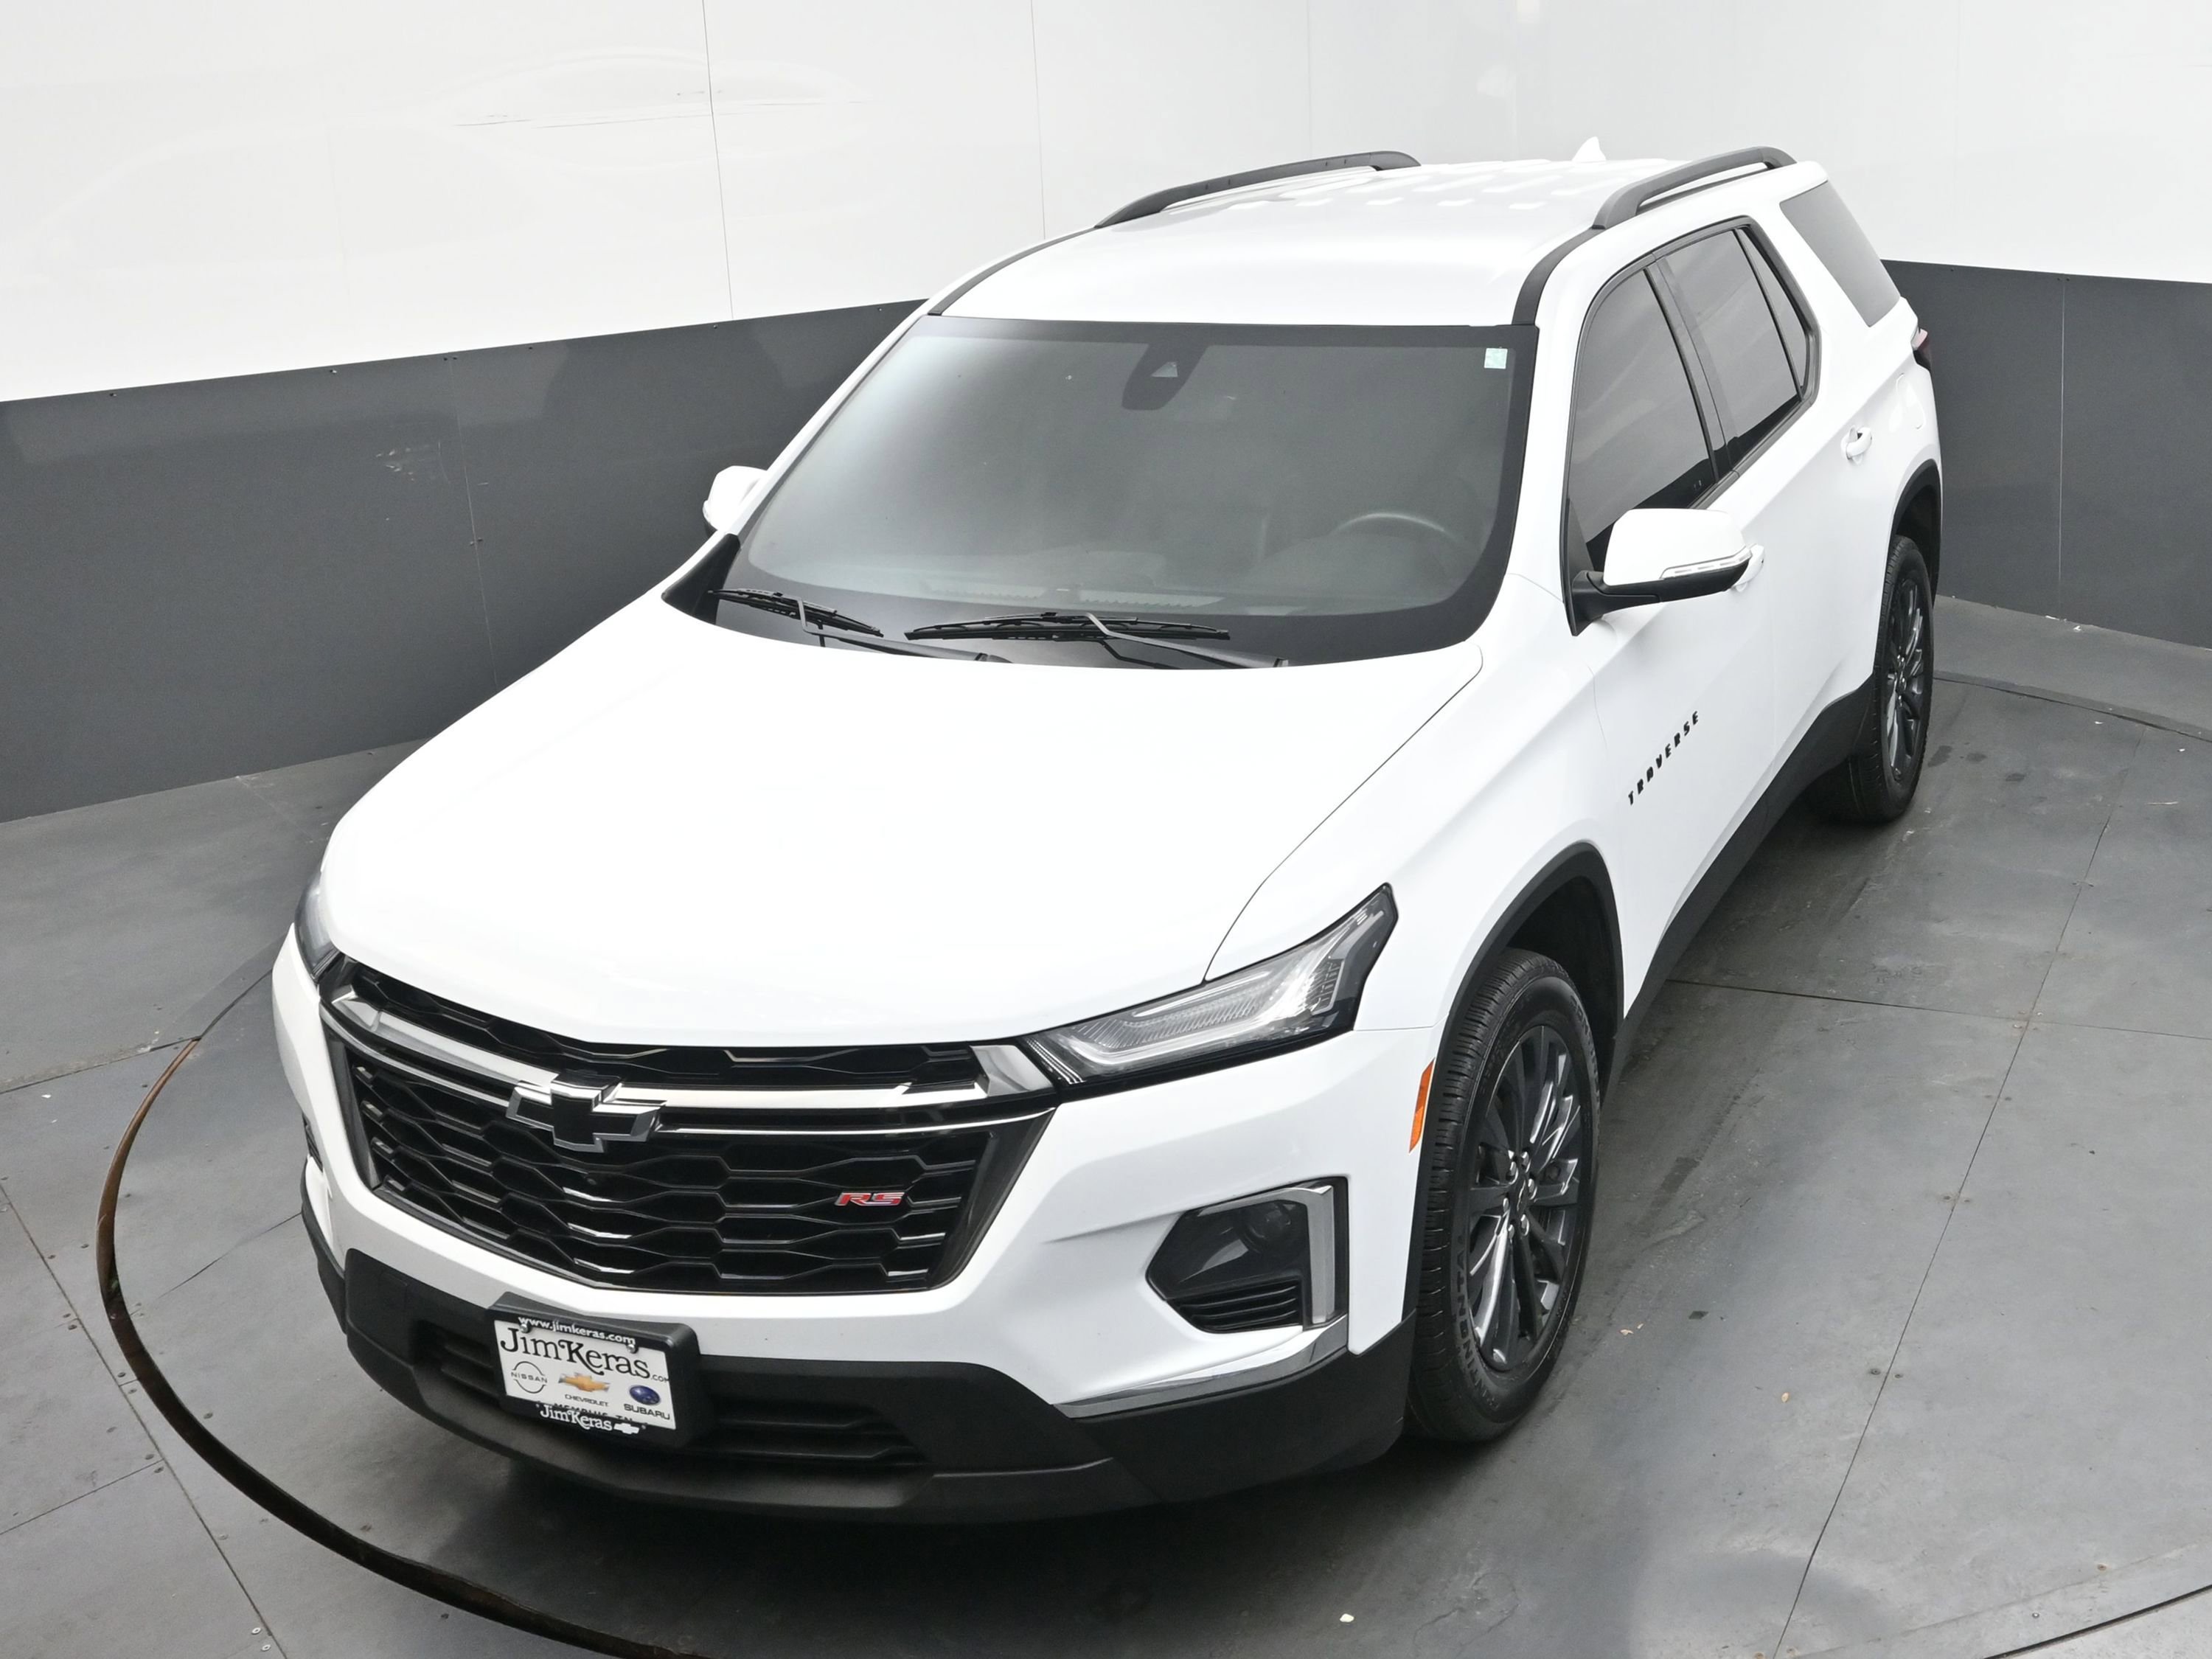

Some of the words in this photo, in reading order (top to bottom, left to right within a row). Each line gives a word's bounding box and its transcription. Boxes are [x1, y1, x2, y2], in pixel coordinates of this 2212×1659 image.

[1628, 711, 1699, 806] TRAVERSE
[834, 1192, 905, 1206] RS
[518, 1316, 636, 1345] www.jimkeras.com
[510, 1371, 548, 1383] NISSAN
[564, 1394, 609, 1407] CHEVROLET
[623, 1403, 670, 1420] SUBARU
